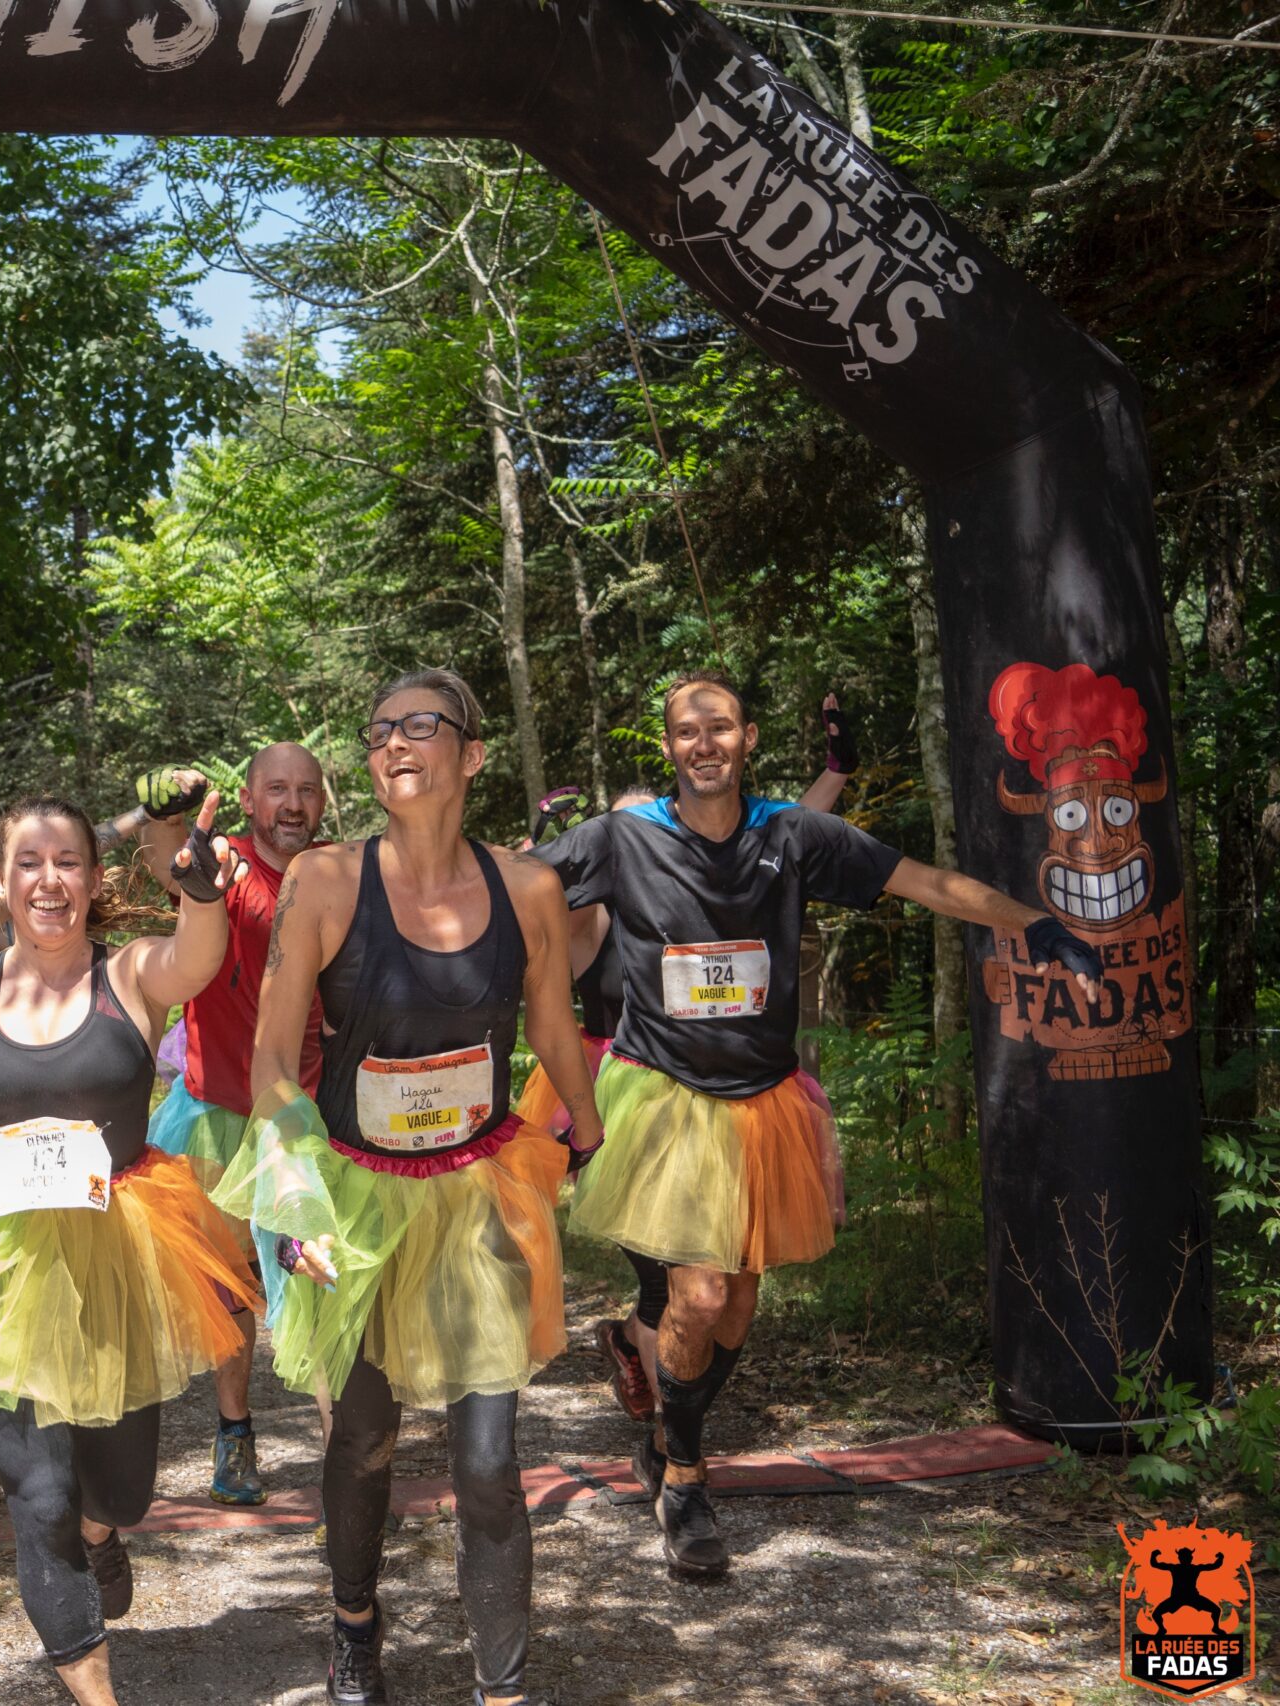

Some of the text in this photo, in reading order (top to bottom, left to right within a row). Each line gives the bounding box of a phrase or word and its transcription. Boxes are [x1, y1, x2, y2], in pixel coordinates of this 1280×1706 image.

[715, 55, 983, 294] LA RUEE DES
[646, 91, 946, 364] FADAS
[1146, 924, 1181, 963] DES
[702, 955, 732, 964] ANTHONY
[703, 965, 735, 985] 124
[698, 987, 736, 1000] VAGUE 1
[1013, 960, 1185, 1030] FADAS
[377, 1063, 414, 1073] Team
[406, 1100, 433, 1112] 124
[406, 1111, 442, 1129] VAGUE
[368, 1135, 401, 1147] HARIBO
[435, 1130, 456, 1144] FUN
